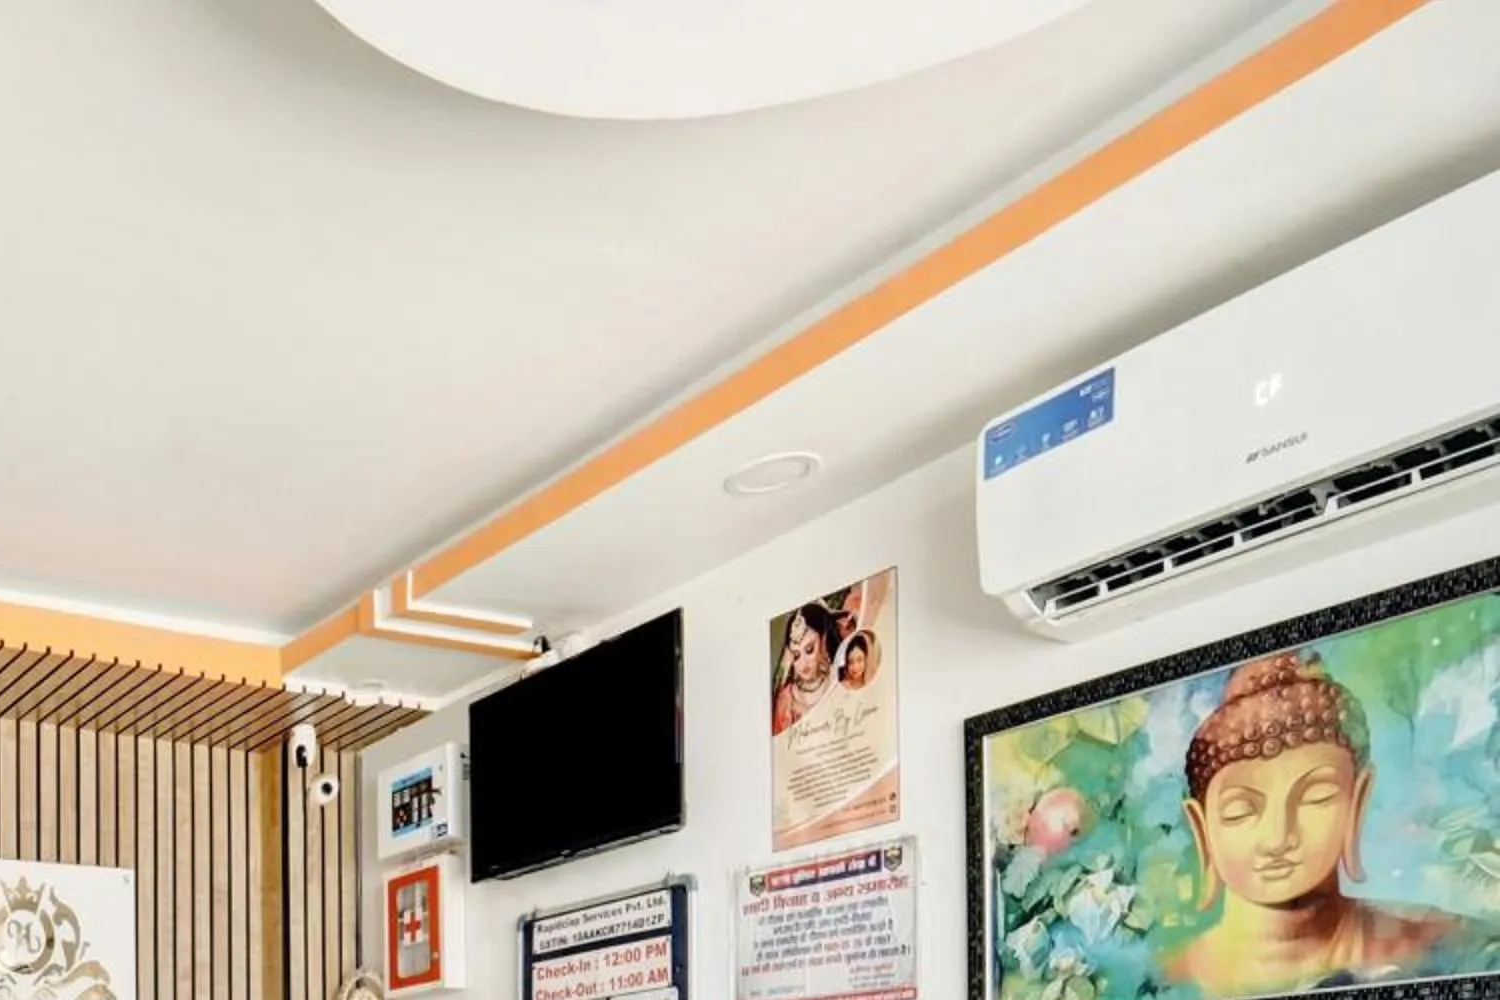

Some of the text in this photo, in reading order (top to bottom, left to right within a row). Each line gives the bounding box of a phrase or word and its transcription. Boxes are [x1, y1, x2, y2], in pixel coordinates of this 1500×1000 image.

[537, 959, 591, 980] Check-In
[604, 947, 641, 967] 12:00
[645, 942, 668, 958] PM
[610, 971, 644, 990] 11:00
[647, 967, 670, 983] AM
